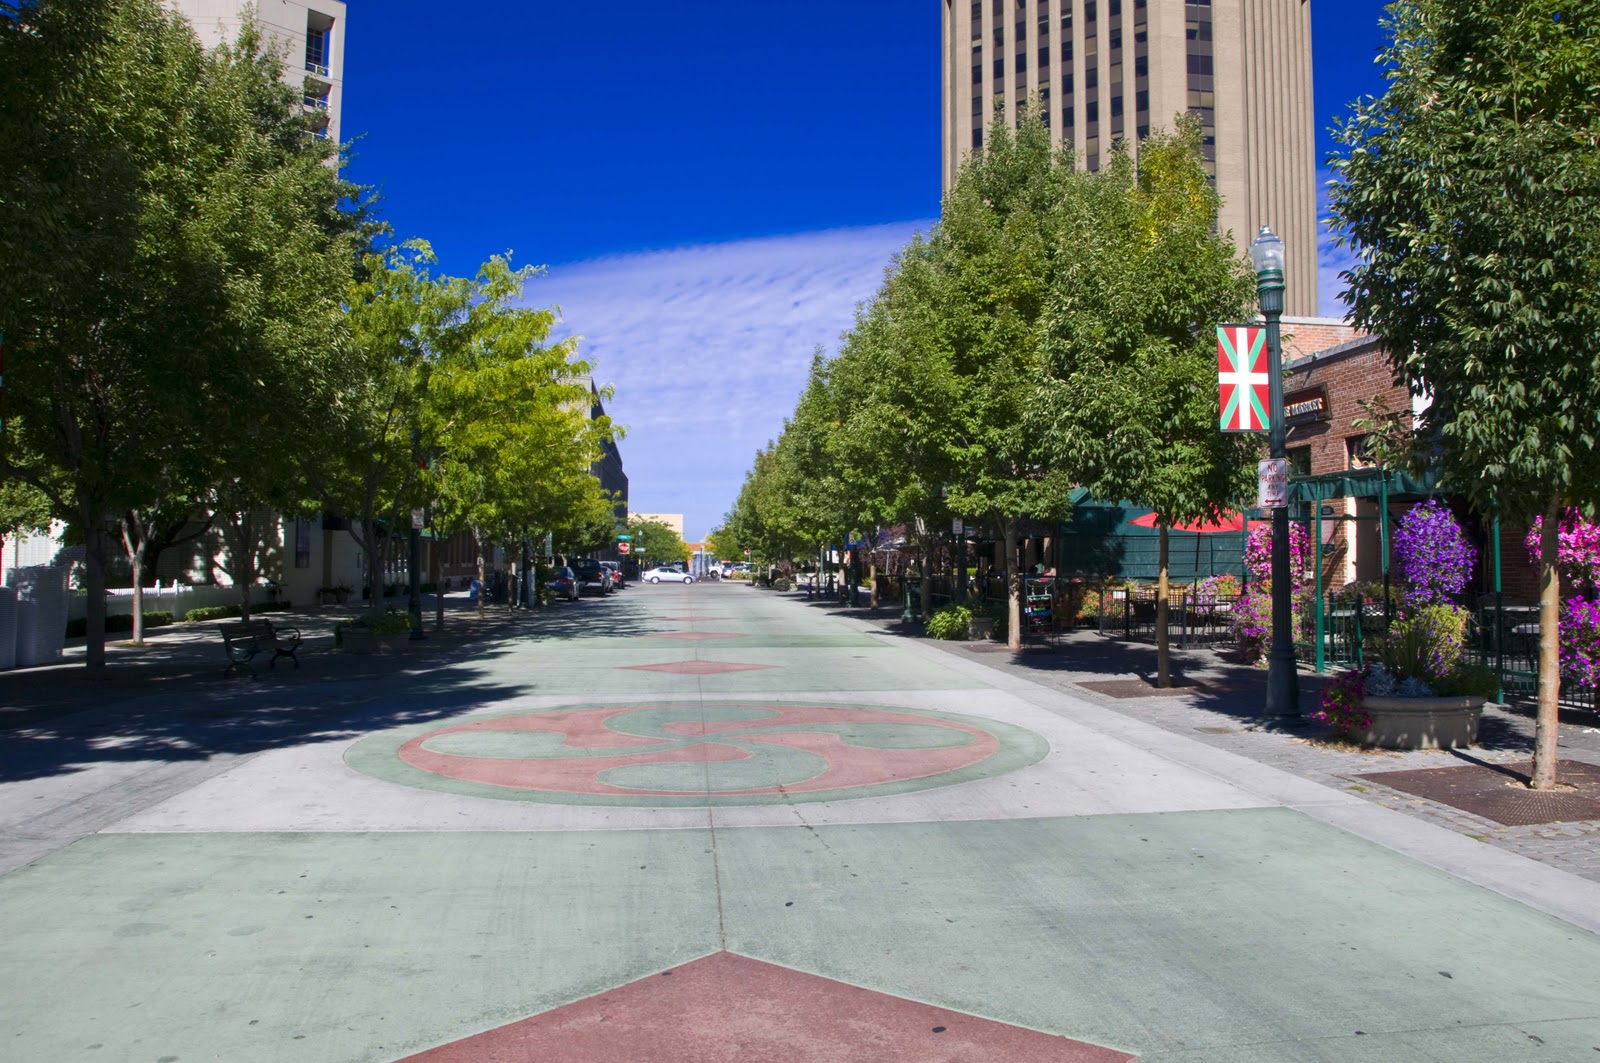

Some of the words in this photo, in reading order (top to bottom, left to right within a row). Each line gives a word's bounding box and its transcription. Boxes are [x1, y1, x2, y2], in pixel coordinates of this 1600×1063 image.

[1290, 398, 1323, 416] MARKET
[1267, 463, 1279, 473] NO
[1261, 473, 1285, 483] PARKING
